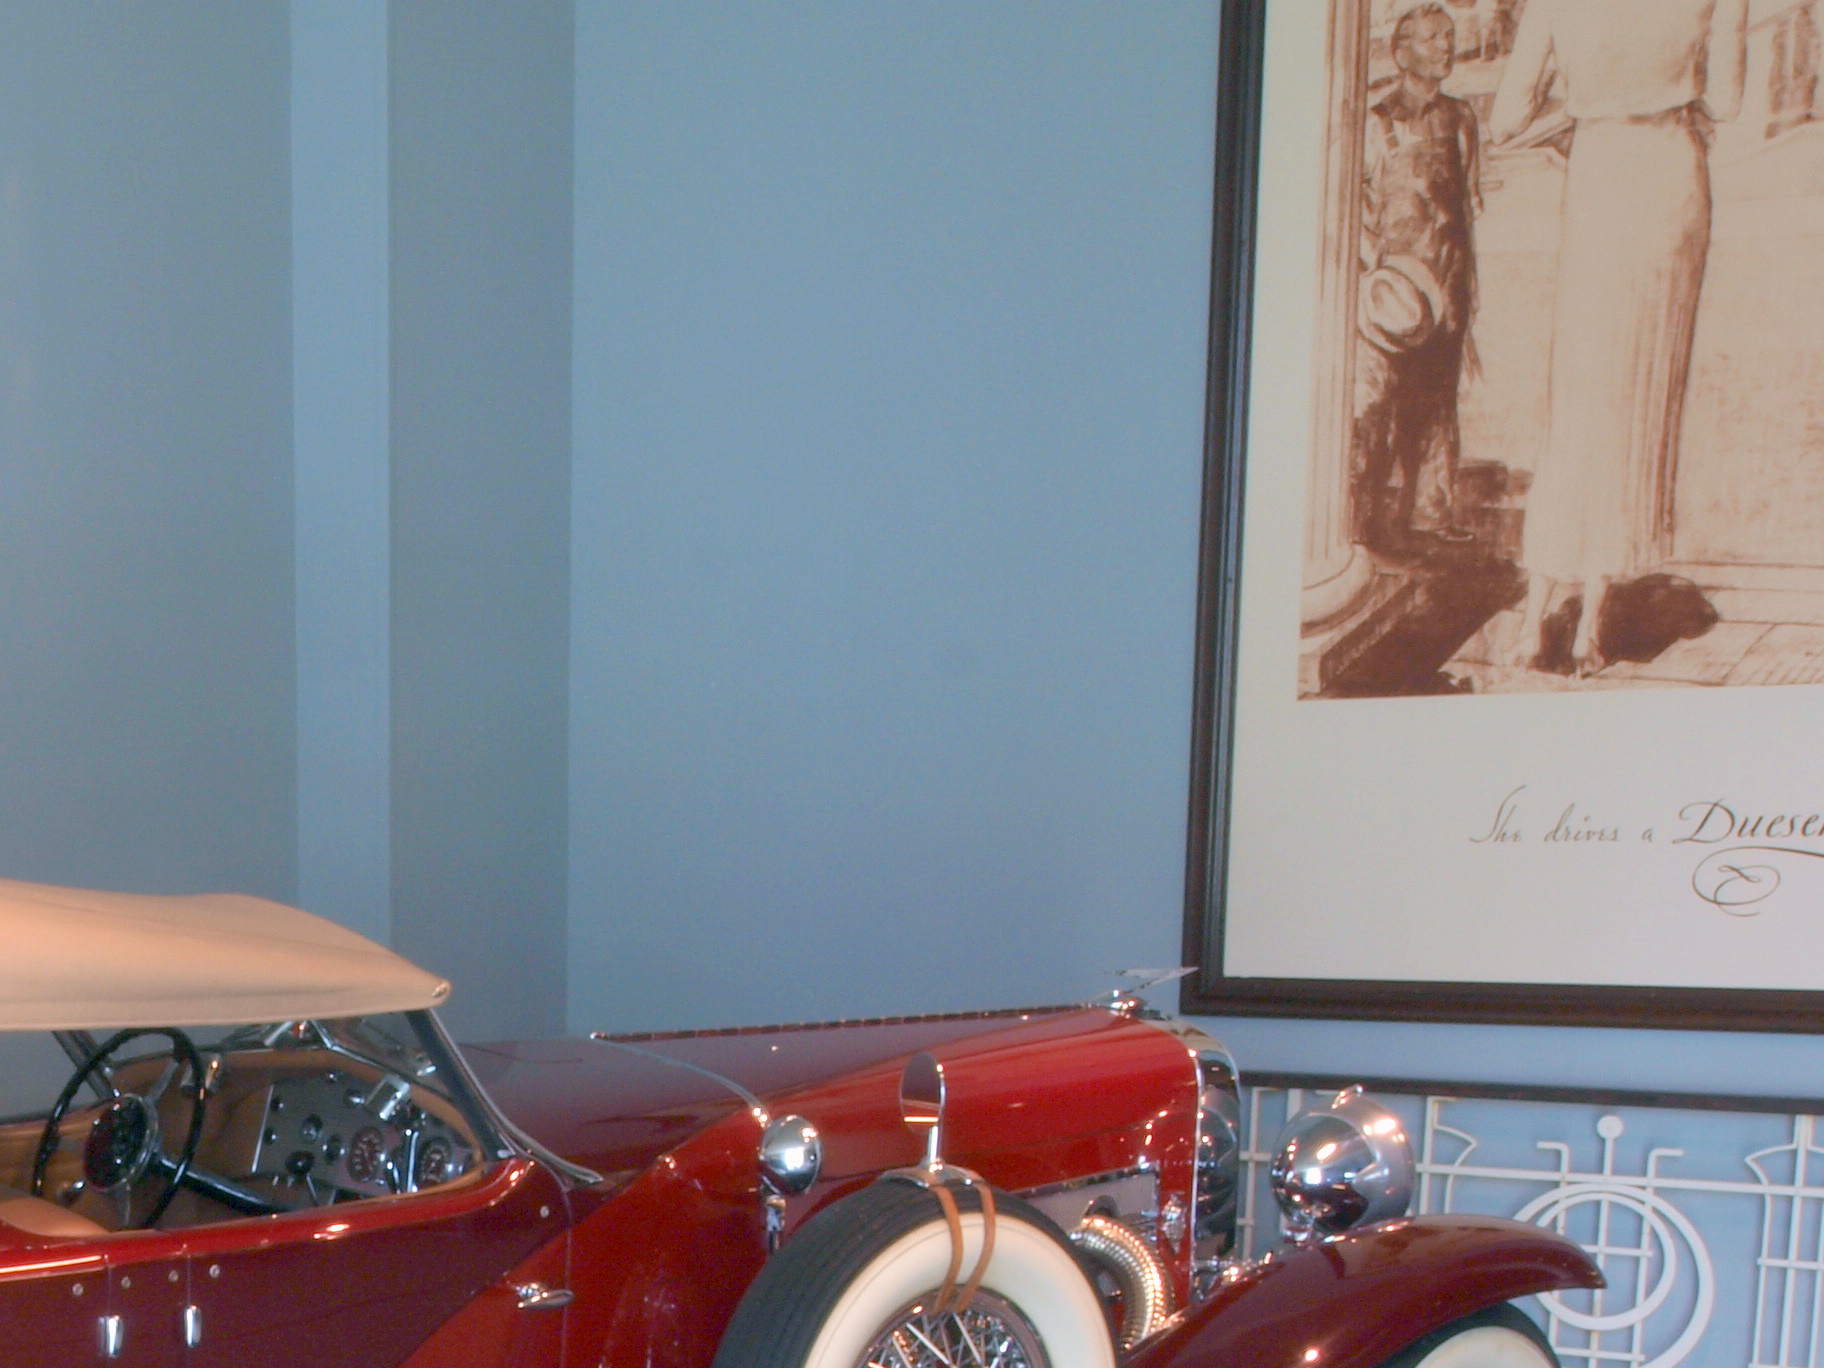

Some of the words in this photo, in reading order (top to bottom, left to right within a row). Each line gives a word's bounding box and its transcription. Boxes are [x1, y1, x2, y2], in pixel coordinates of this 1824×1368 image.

[1468, 784, 1526, 844] She
[1542, 801, 1619, 843] drives
[1640, 826, 1654, 843] a
